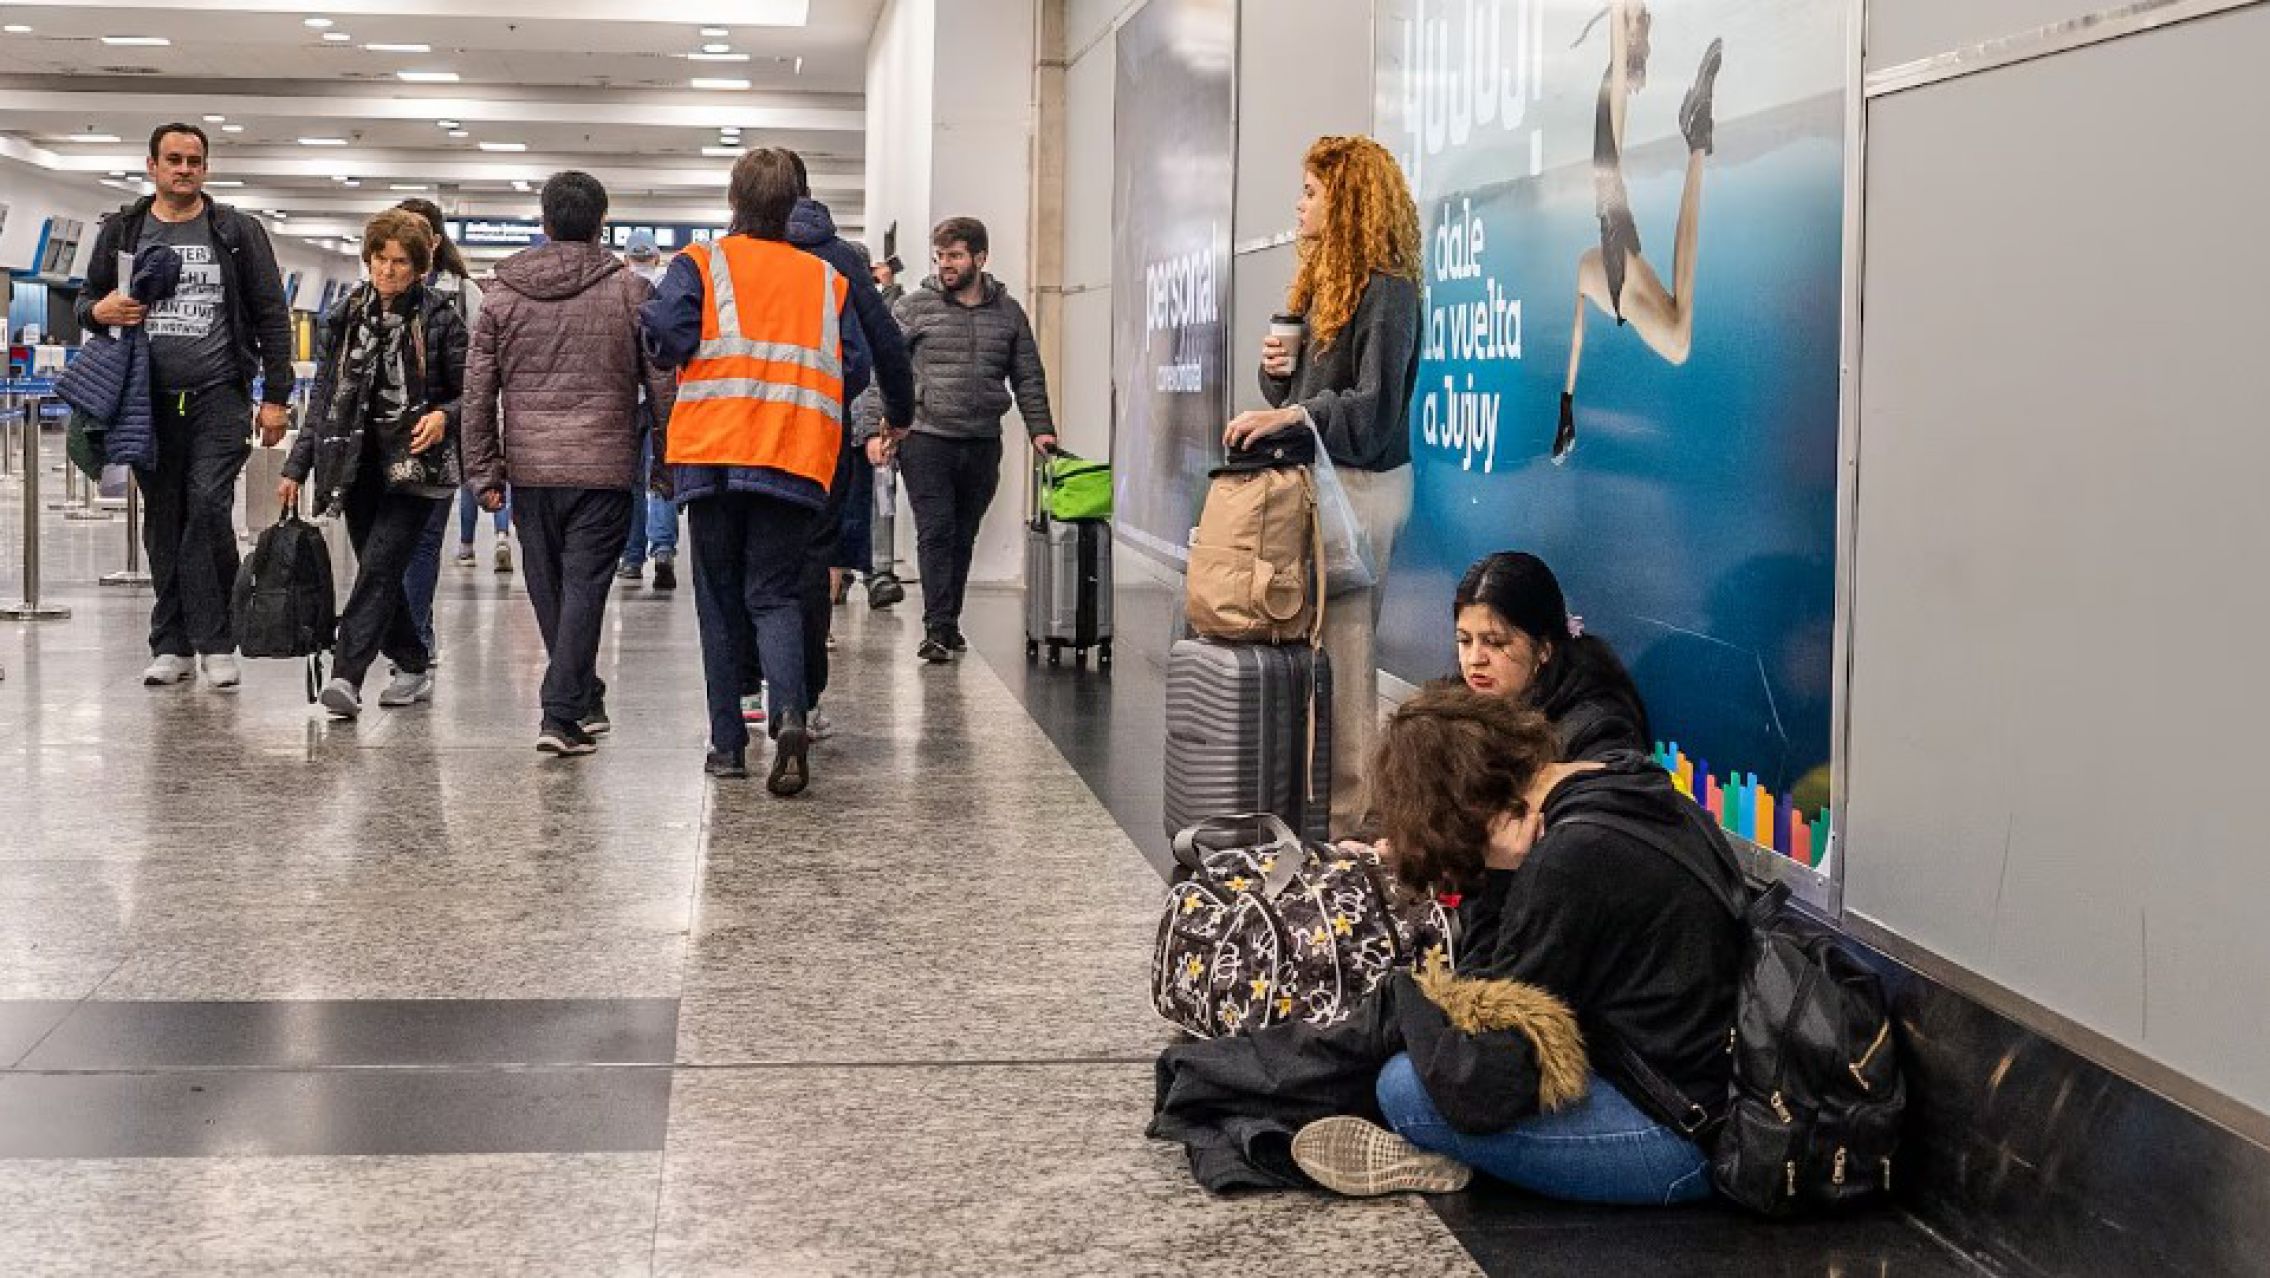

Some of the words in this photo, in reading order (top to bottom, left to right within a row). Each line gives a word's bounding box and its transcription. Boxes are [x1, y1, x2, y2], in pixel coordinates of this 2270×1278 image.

[1146, 220, 1218, 352] personal
[1434, 197, 1484, 282] dale
[1424, 285, 1446, 361] la
[1449, 277, 1522, 361] vuelta
[1423, 392, 1438, 445] a
[1440, 372, 1501, 474] Jujuy
